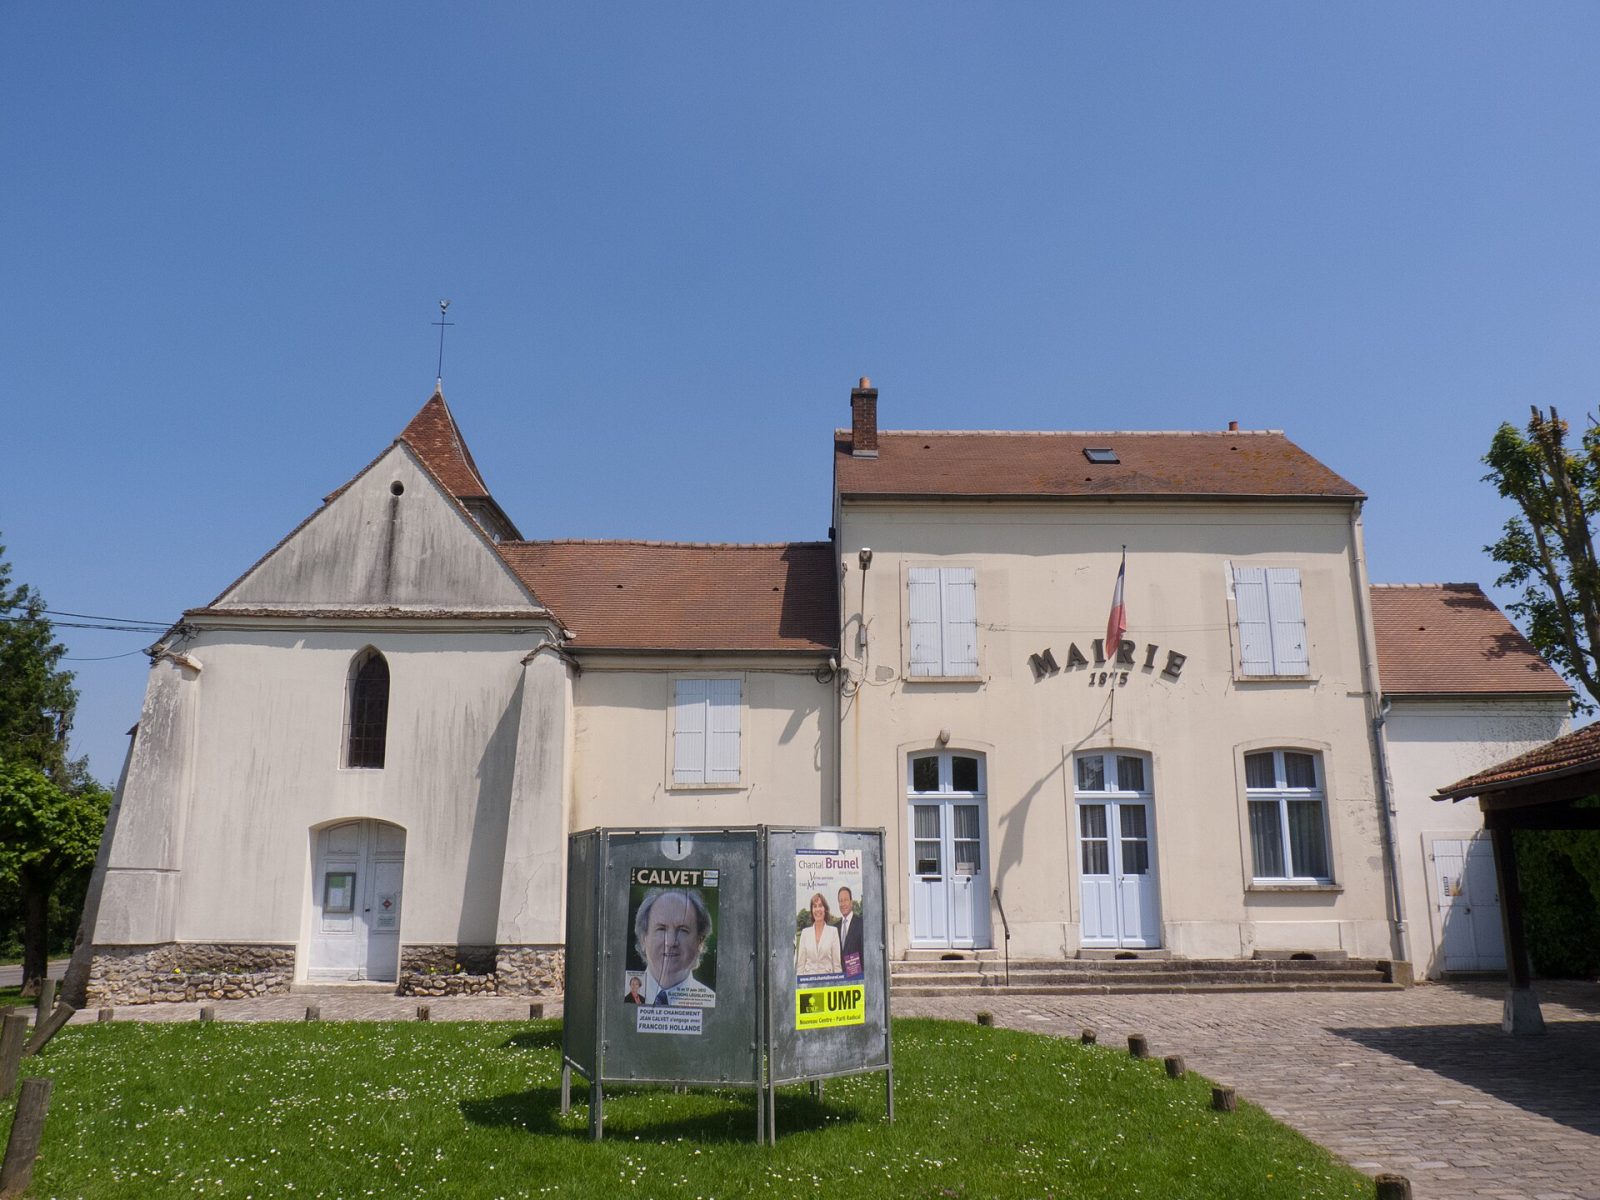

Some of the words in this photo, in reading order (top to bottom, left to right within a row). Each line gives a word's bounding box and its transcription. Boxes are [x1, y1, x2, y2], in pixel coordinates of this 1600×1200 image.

[1029, 638, 1187, 680] MAIRIE
[676, 836, 681, 854] 1
[798, 860, 824, 869] Chantal
[825, 857, 859, 869] Brunel
[636, 869, 702, 886] CALVET
[827, 989, 861, 1012] UMP
[669, 1024, 701, 1032] HOLLANDE
